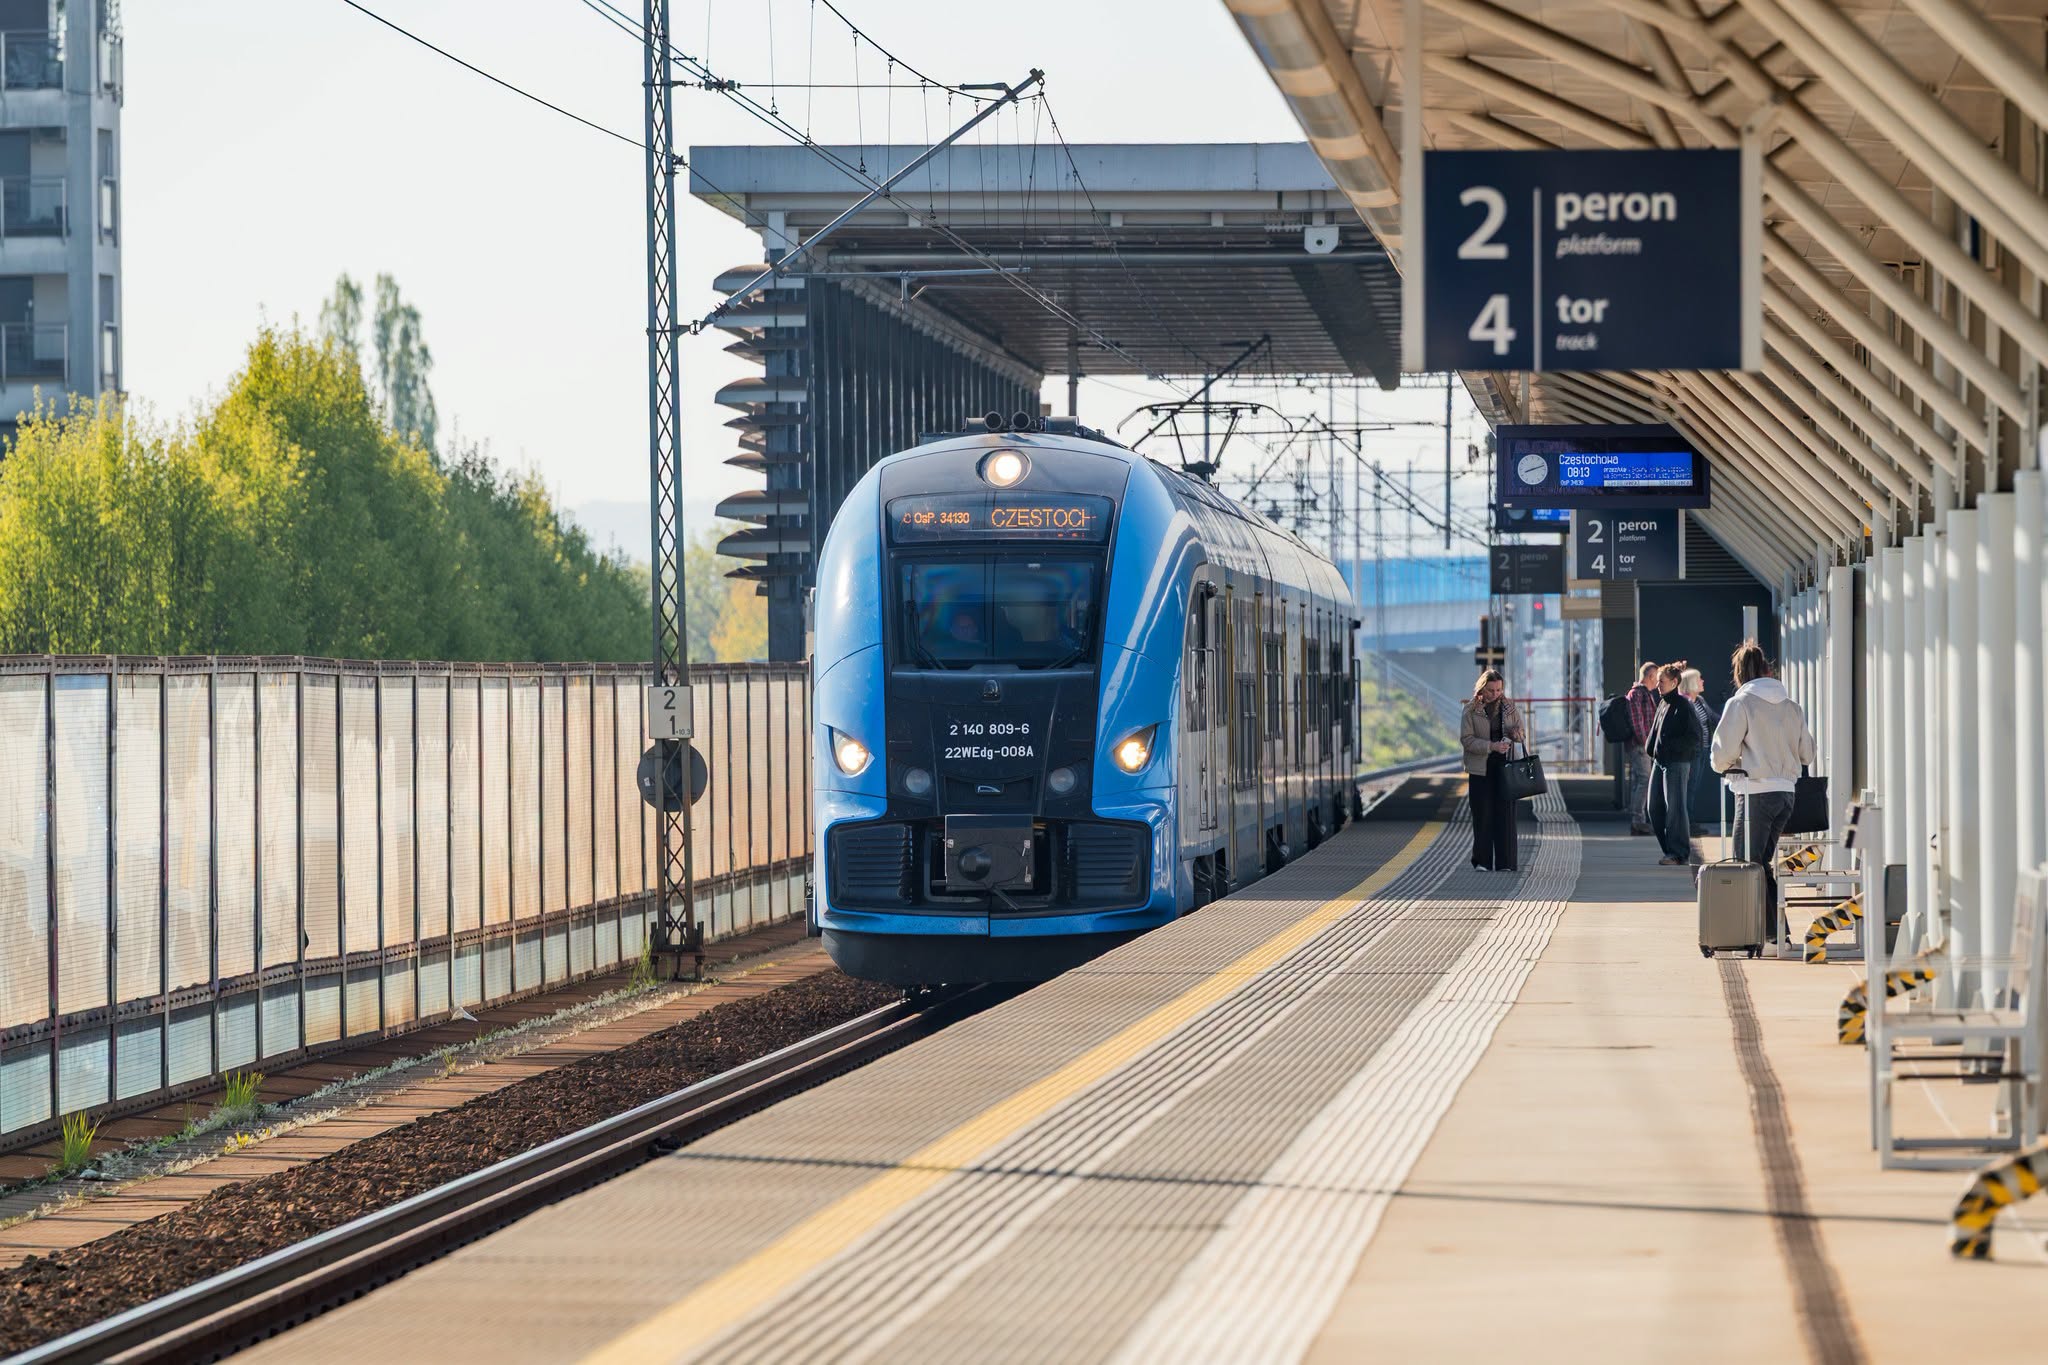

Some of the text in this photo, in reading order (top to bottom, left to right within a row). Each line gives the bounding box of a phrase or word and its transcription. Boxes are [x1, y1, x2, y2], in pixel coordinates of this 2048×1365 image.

[1556, 191, 1678, 230] peron
[1457, 185, 1509, 260] 2
[1556, 233, 1642, 259] platform
[1556, 295, 1609, 324] tor
[1468, 294, 1517, 355] 4
[1556, 332, 1598, 351] track
[1558, 454, 1619, 466] Częstochowa
[914, 512, 937, 524] OsP.
[940, 512, 970, 524] 34130
[1618, 521, 1657, 534] peron
[1587, 520, 1604, 543] 2
[1498, 553, 1511, 570] 2
[1519, 553, 1549, 563] peron
[1590, 554, 1606, 574] 4
[1618, 554, 1636, 564] tor
[1500, 576, 1513, 591] 4
[663, 689, 676, 710] 2
[669, 715, 676, 735] 1
[949, 723, 1030, 736] 2 140 809-6
[944, 745, 1034, 760] 22WEdg-008A
